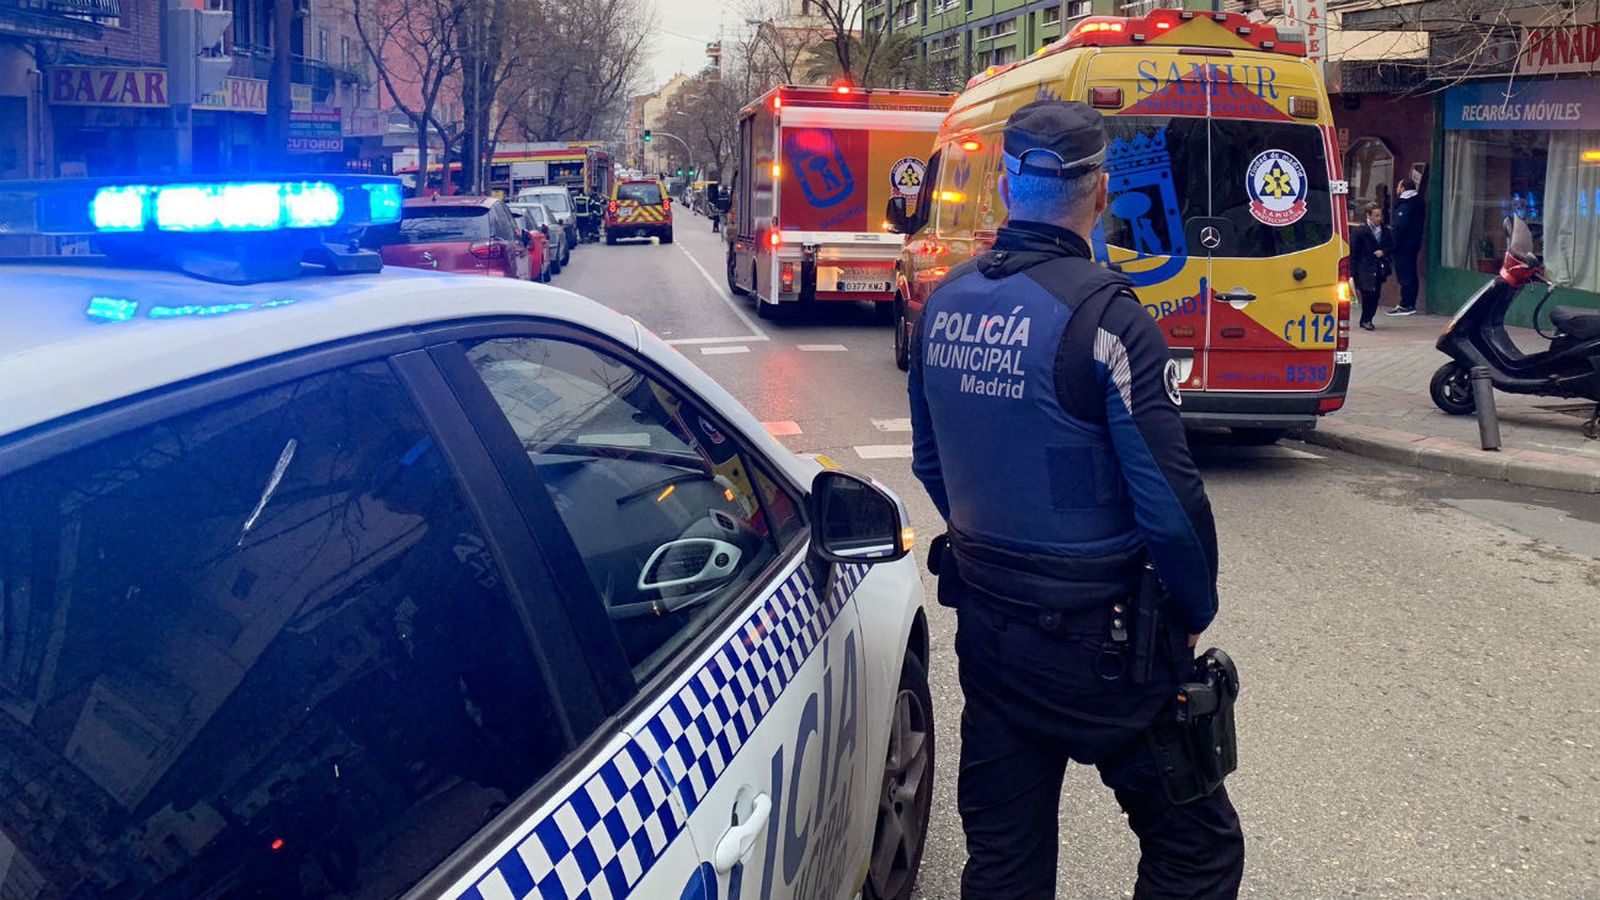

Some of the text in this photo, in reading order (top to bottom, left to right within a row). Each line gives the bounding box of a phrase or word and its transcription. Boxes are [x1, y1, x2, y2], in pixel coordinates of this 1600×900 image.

[53, 70, 166, 105] BAZAR
[1136, 59, 1279, 100] SAMUR
[1461, 100, 1582, 121] RECARGAS MÓVILES
[1249, 154, 1268, 177] ciudad
[1282, 154, 1304, 177] madrid
[929, 305, 1031, 347] POLICÍA
[926, 342, 1025, 376] MUNICIPAL
[960, 373, 1025, 399] Madrid
